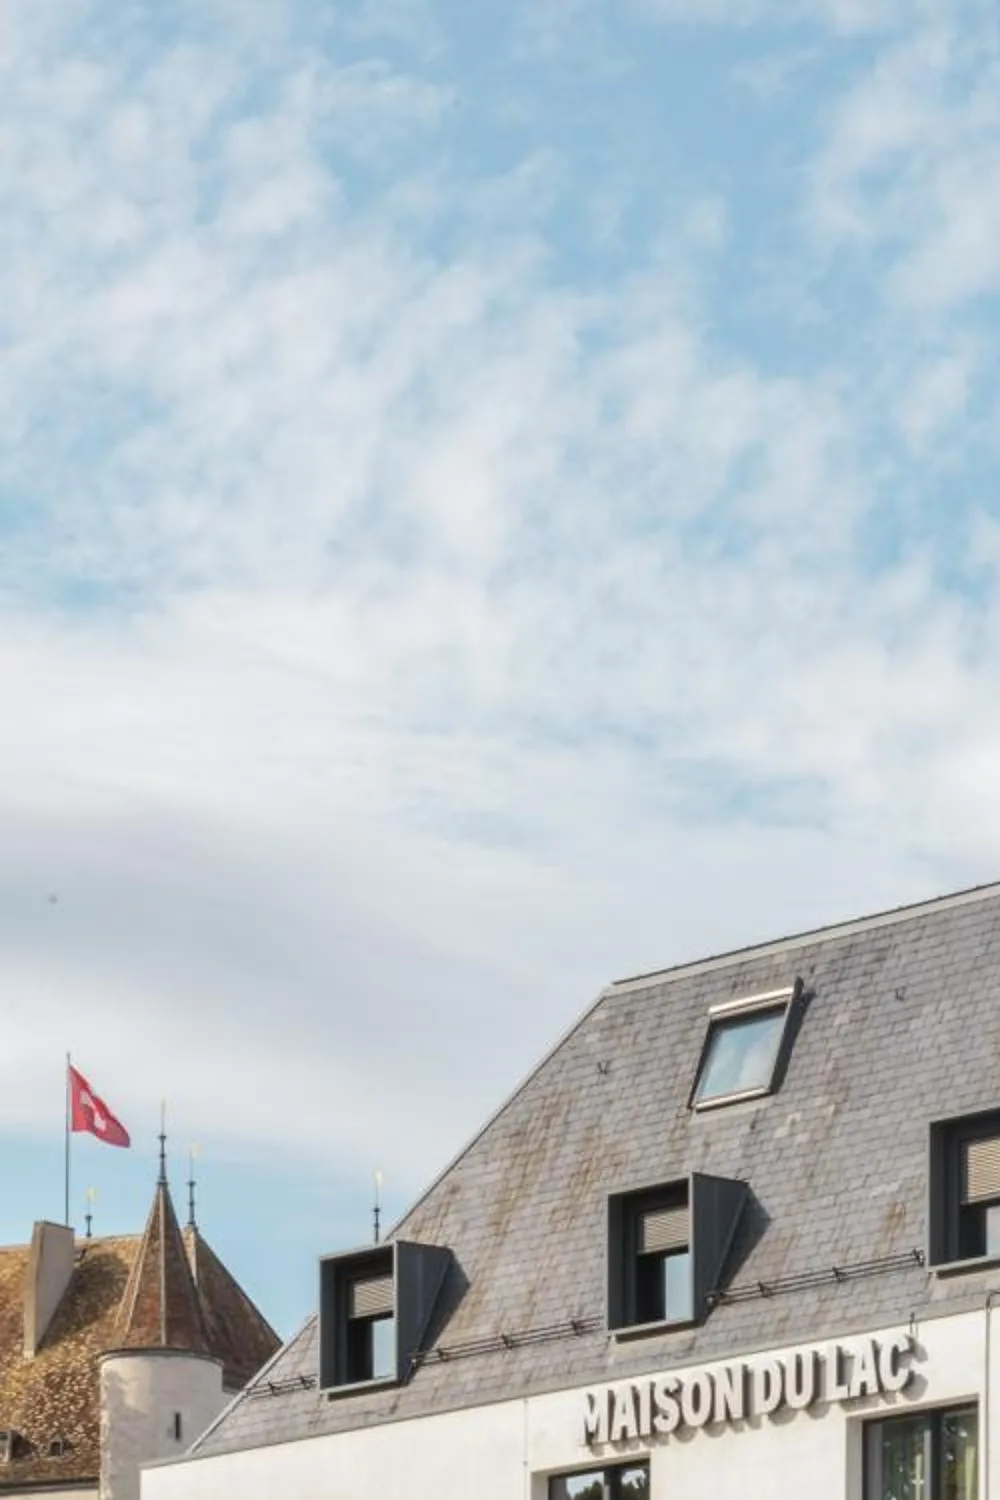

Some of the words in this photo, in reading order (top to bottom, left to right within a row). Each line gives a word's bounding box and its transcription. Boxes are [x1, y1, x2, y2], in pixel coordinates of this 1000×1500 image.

[582, 1363, 746, 1445] MAISON
[752, 1349, 814, 1415] DU
[825, 1335, 914, 1401] LAC
